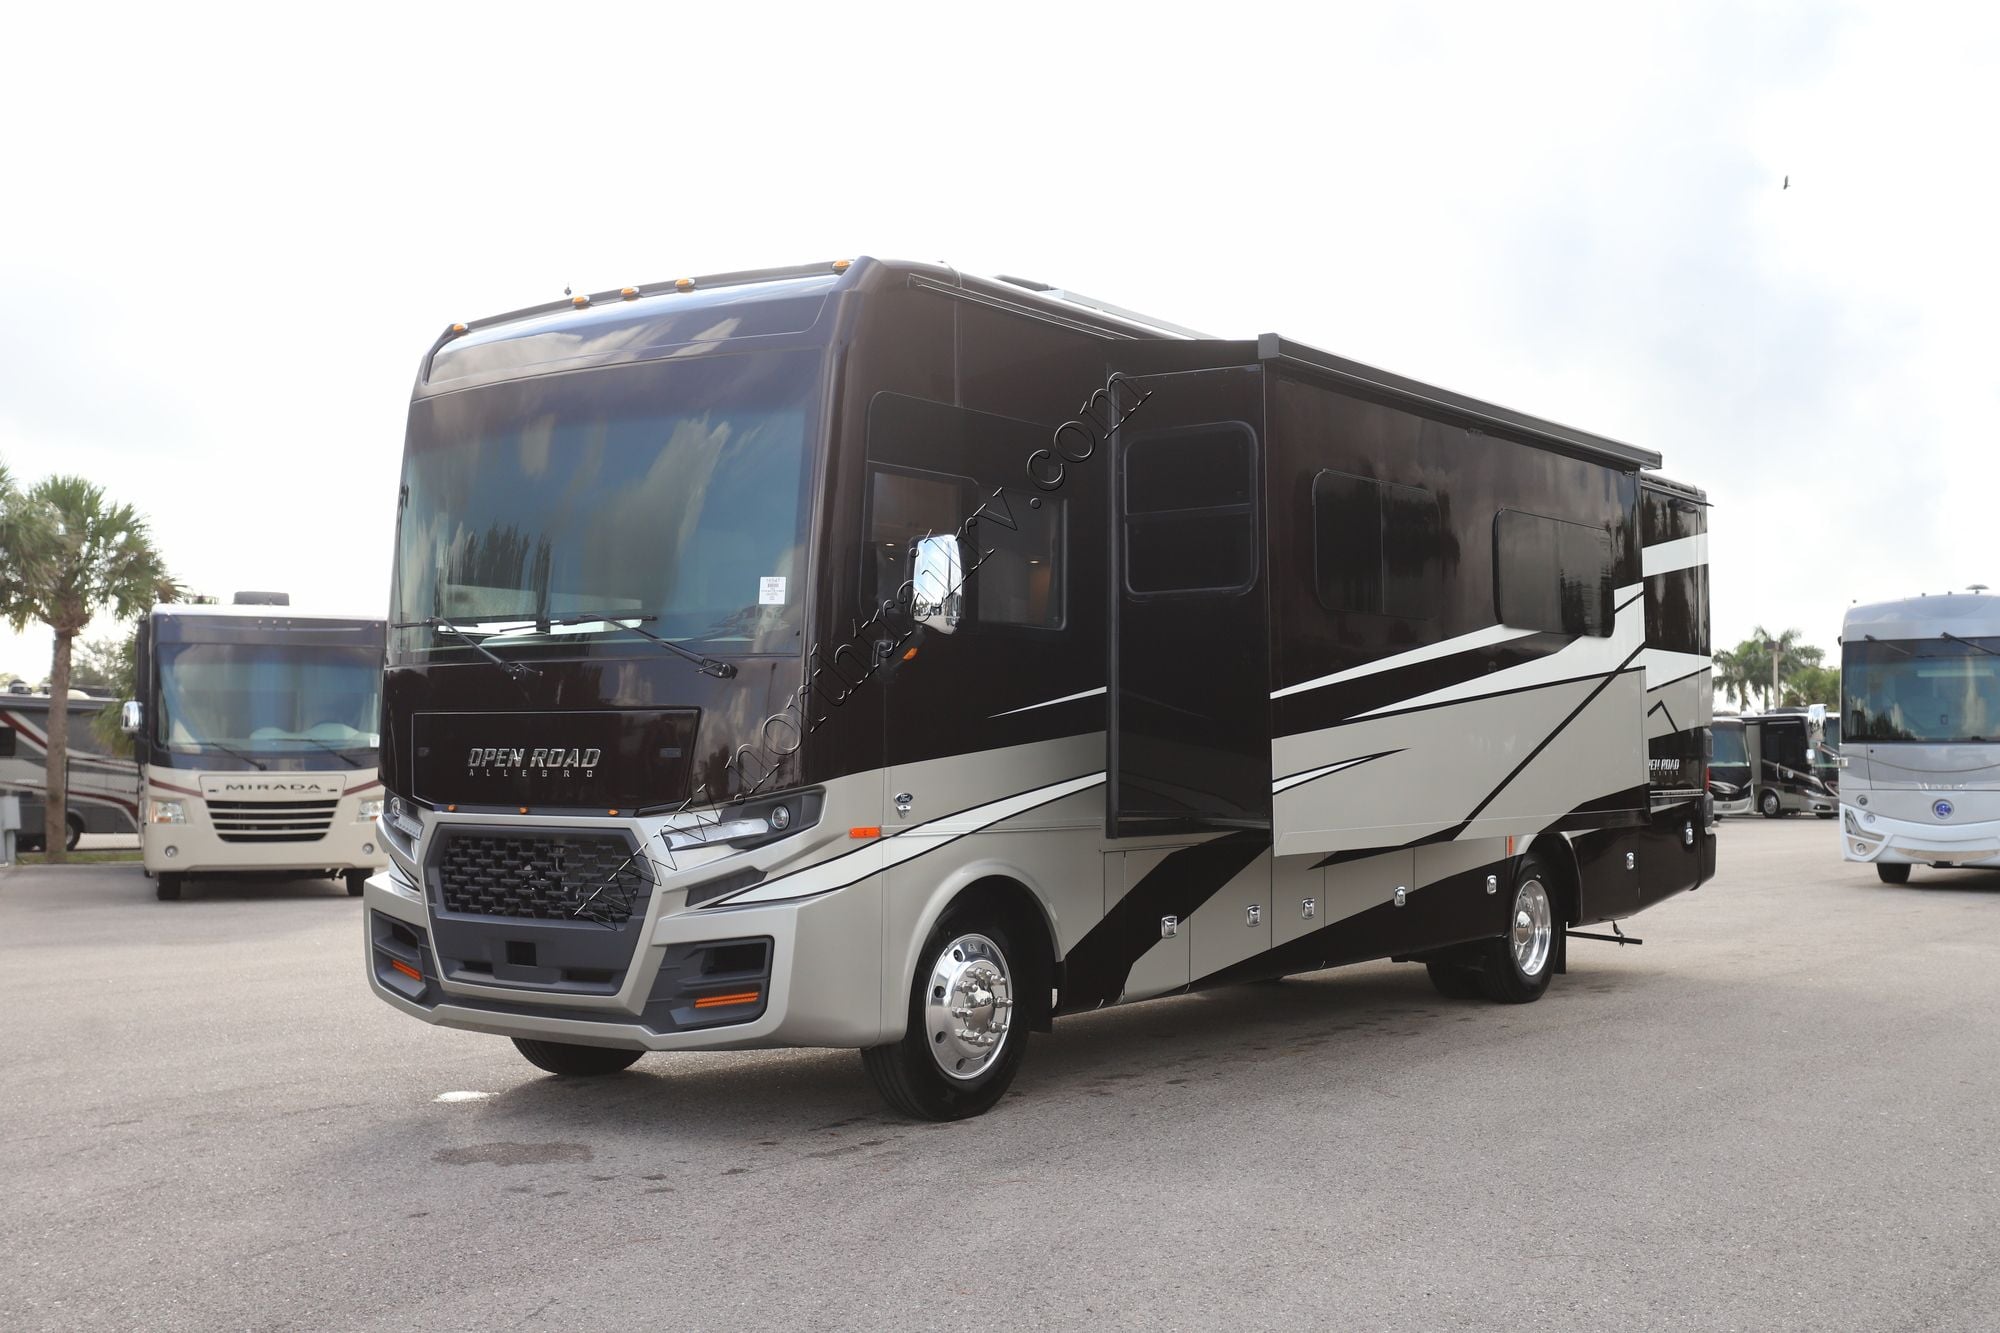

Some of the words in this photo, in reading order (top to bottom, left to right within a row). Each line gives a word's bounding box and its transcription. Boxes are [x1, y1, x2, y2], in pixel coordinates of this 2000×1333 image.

[467, 748, 525, 767] OPEN
[529, 748, 601, 767] ROAD
[1661, 758, 1680, 770] ROAD
[468, 769, 593, 778] ALLEGRO
